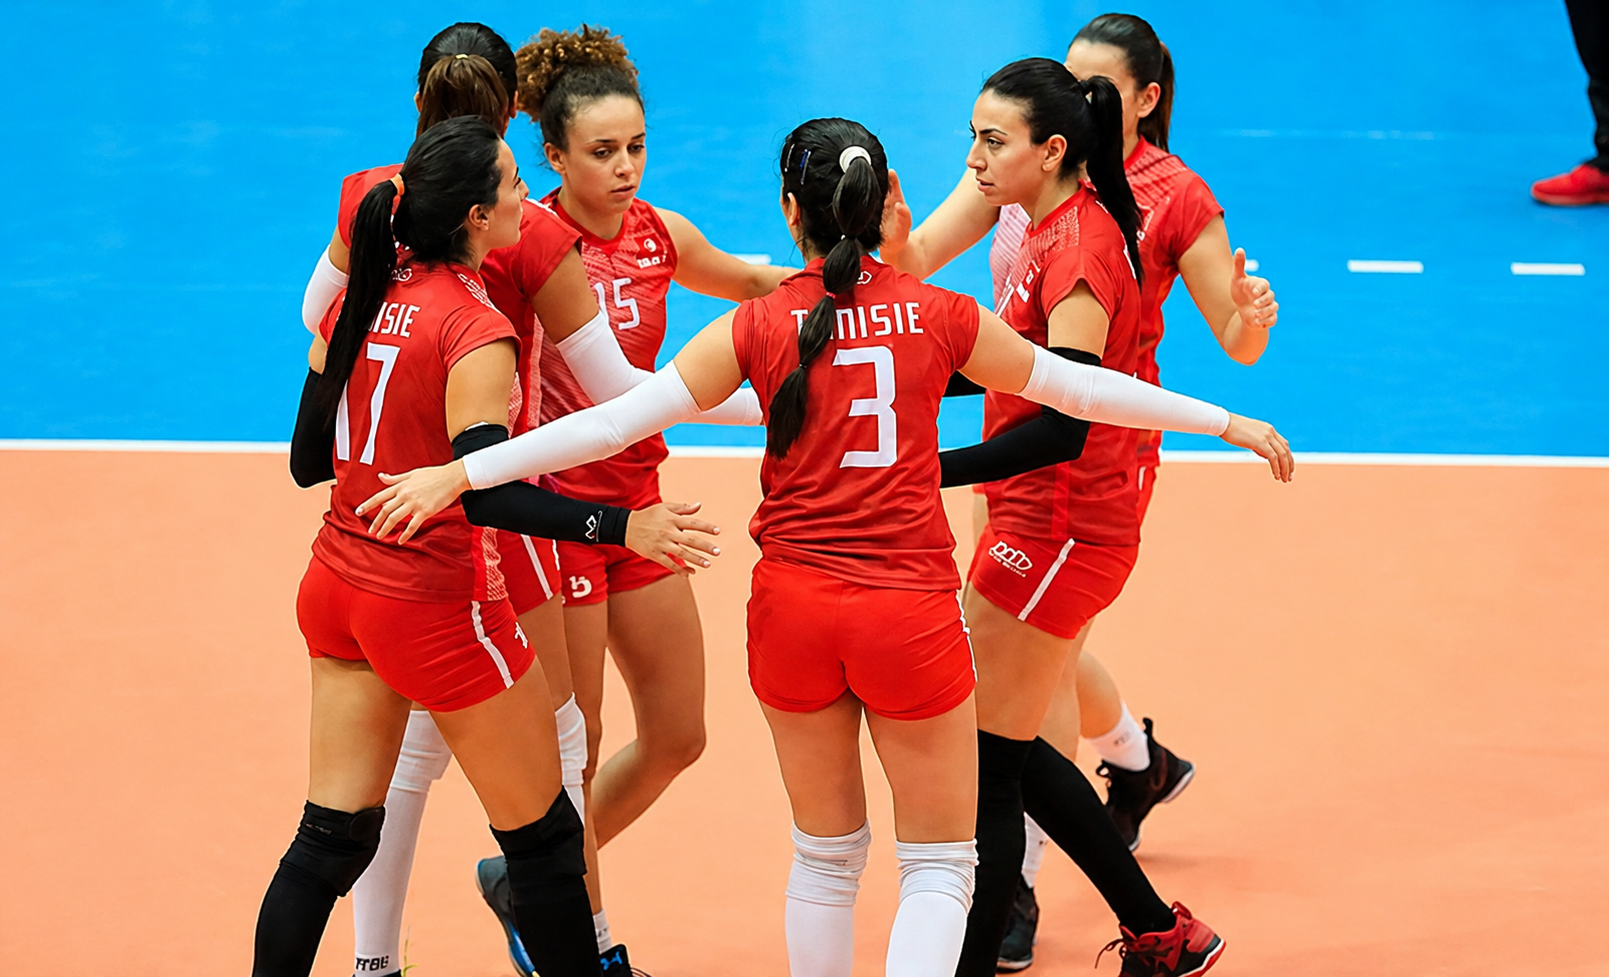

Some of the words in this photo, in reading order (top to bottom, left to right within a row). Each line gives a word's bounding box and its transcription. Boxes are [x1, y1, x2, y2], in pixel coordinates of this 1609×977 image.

[368, 301, 421, 338] ISIE
[790, 302, 924, 340] TNISIE
[832, 345, 898, 468] 3
